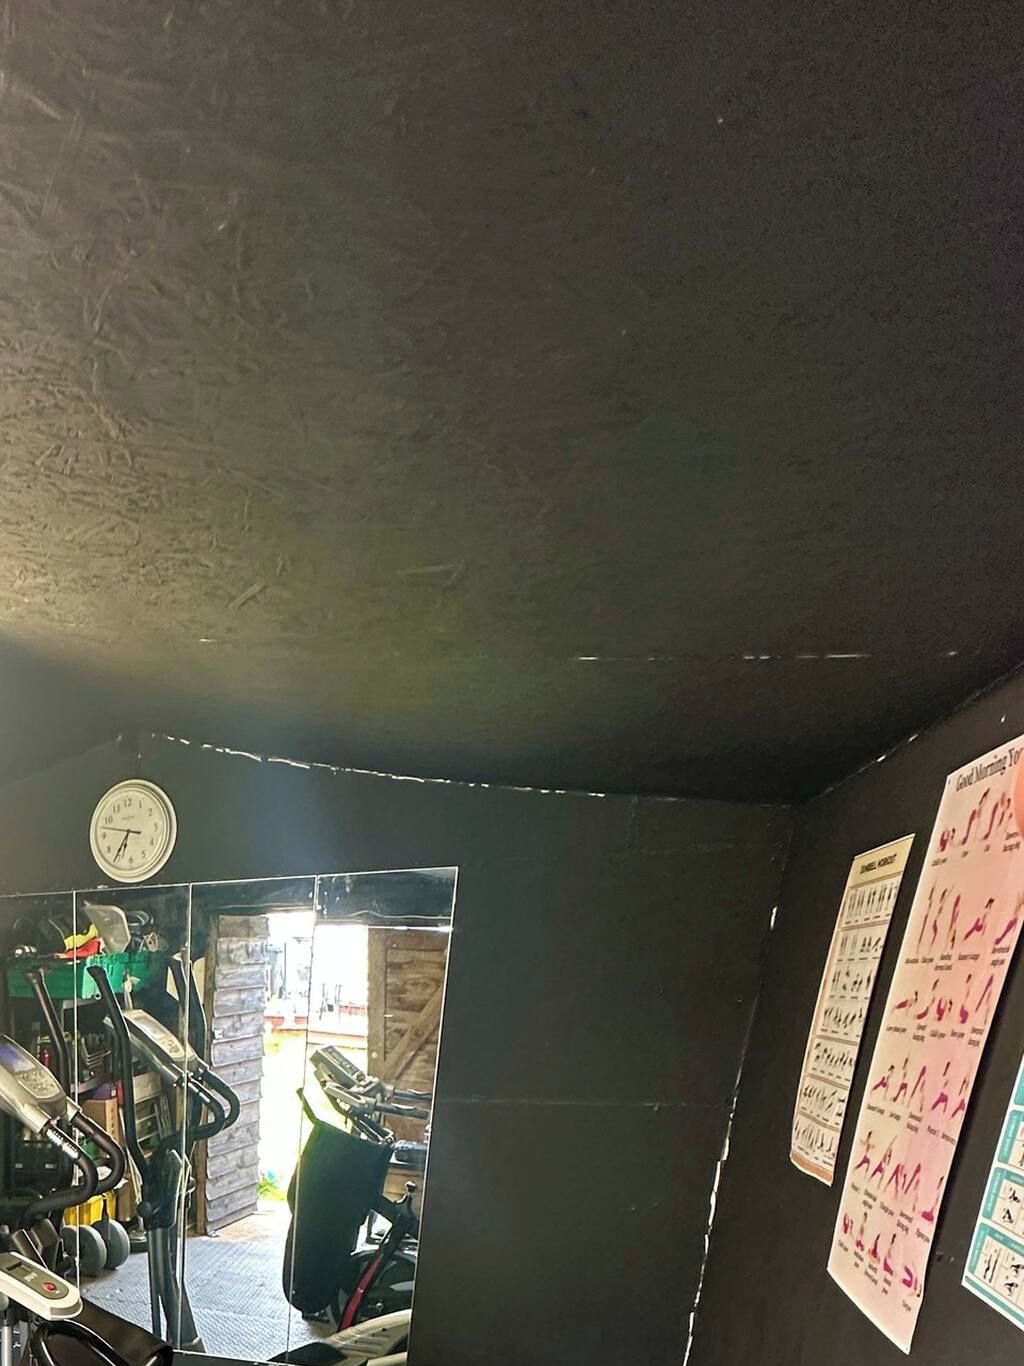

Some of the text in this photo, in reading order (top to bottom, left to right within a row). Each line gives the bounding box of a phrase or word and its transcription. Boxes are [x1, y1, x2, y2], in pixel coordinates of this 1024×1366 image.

[956, 766, 975, 792] Good
[123, 798, 132, 808] 12
[112, 804, 121, 814] 11
[104, 815, 114, 825] 10
